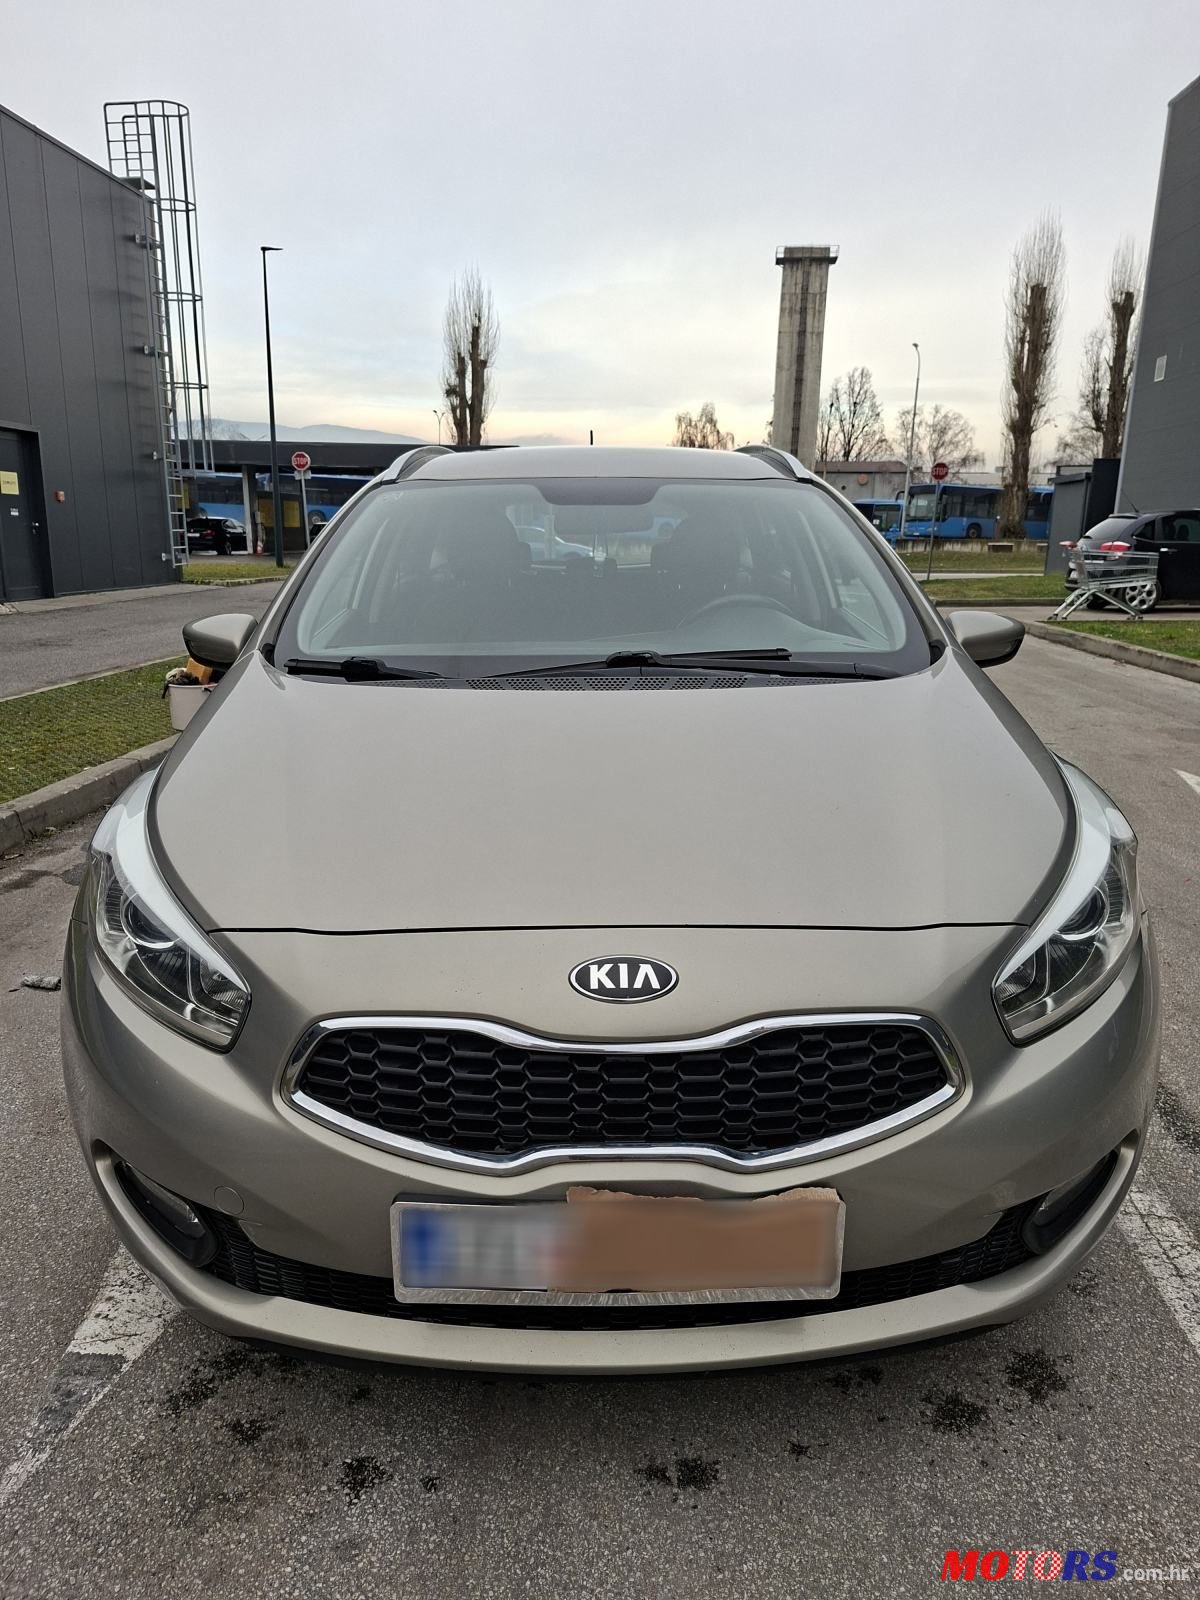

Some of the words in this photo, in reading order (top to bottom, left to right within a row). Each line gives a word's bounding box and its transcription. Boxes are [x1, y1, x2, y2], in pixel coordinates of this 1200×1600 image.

[294, 457, 308, 465] STOP
[932, 466, 948, 476] STOP
[588, 963, 660, 989] KIA
